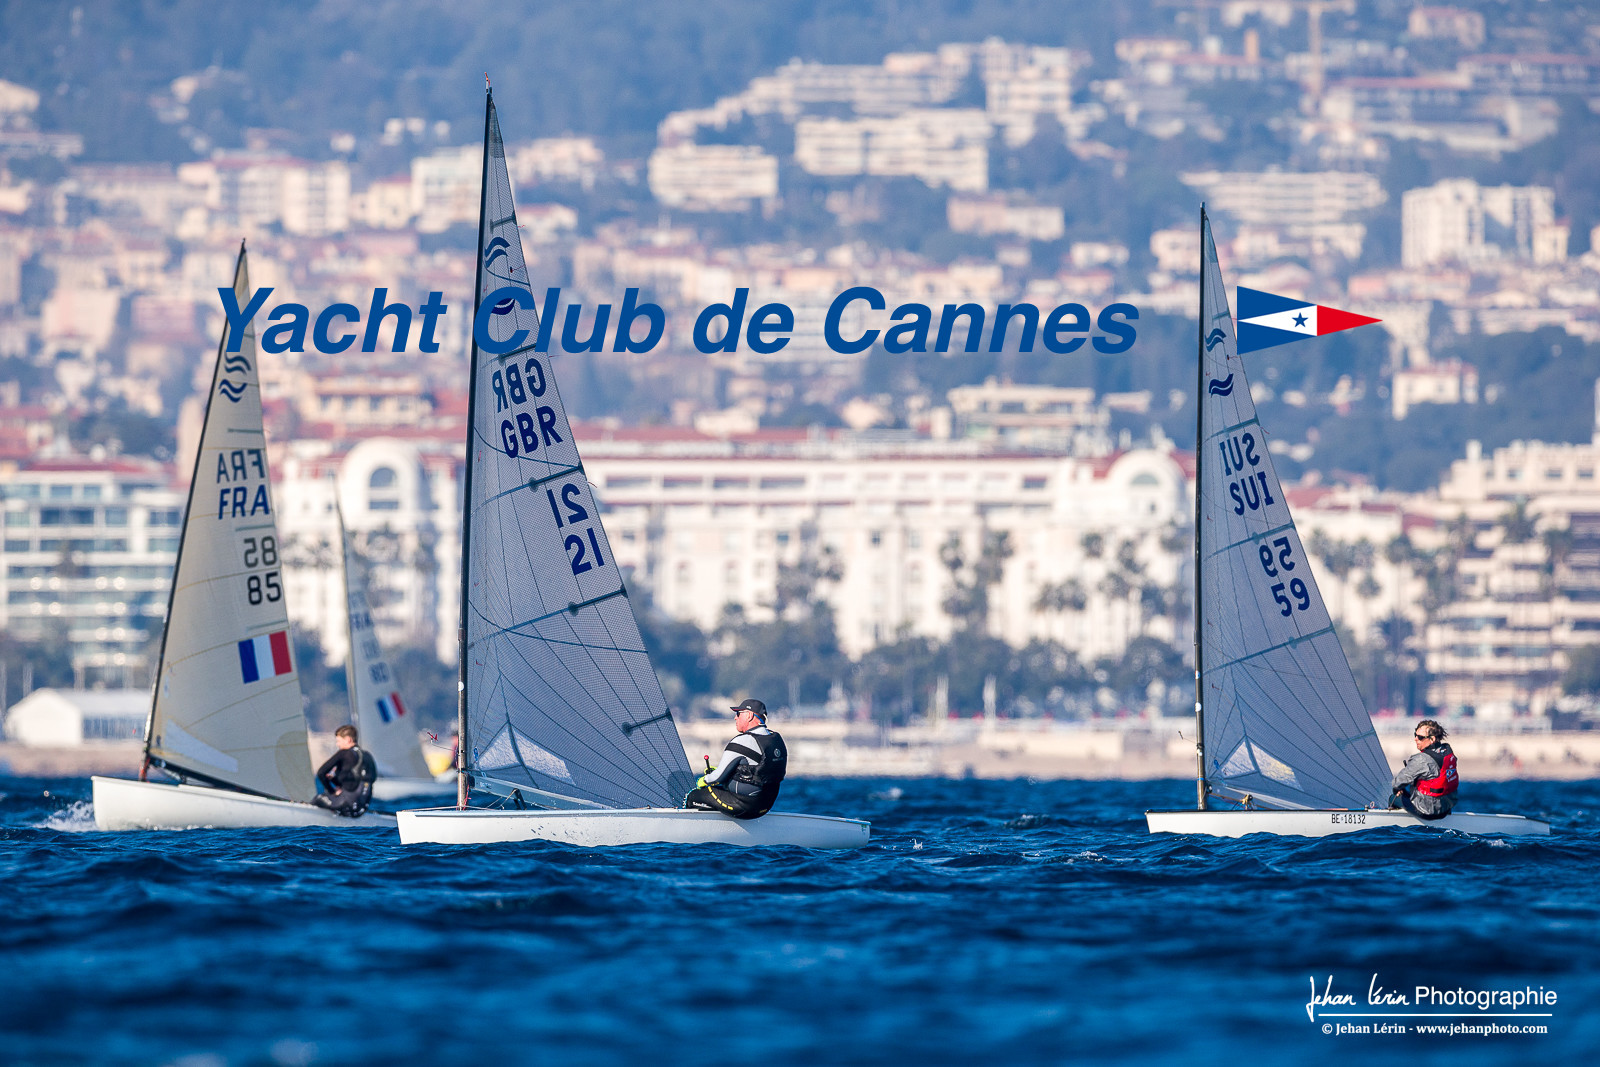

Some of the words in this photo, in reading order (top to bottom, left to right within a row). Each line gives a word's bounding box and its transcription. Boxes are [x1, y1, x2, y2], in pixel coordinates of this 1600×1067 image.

[500, 406, 563, 458] GBR
[218, 484, 270, 519] FRA
[1229, 471, 1274, 515] SUI
[564, 528, 605, 576] 21
[247, 571, 282, 605] 85
[1271, 578, 1310, 617] 59
